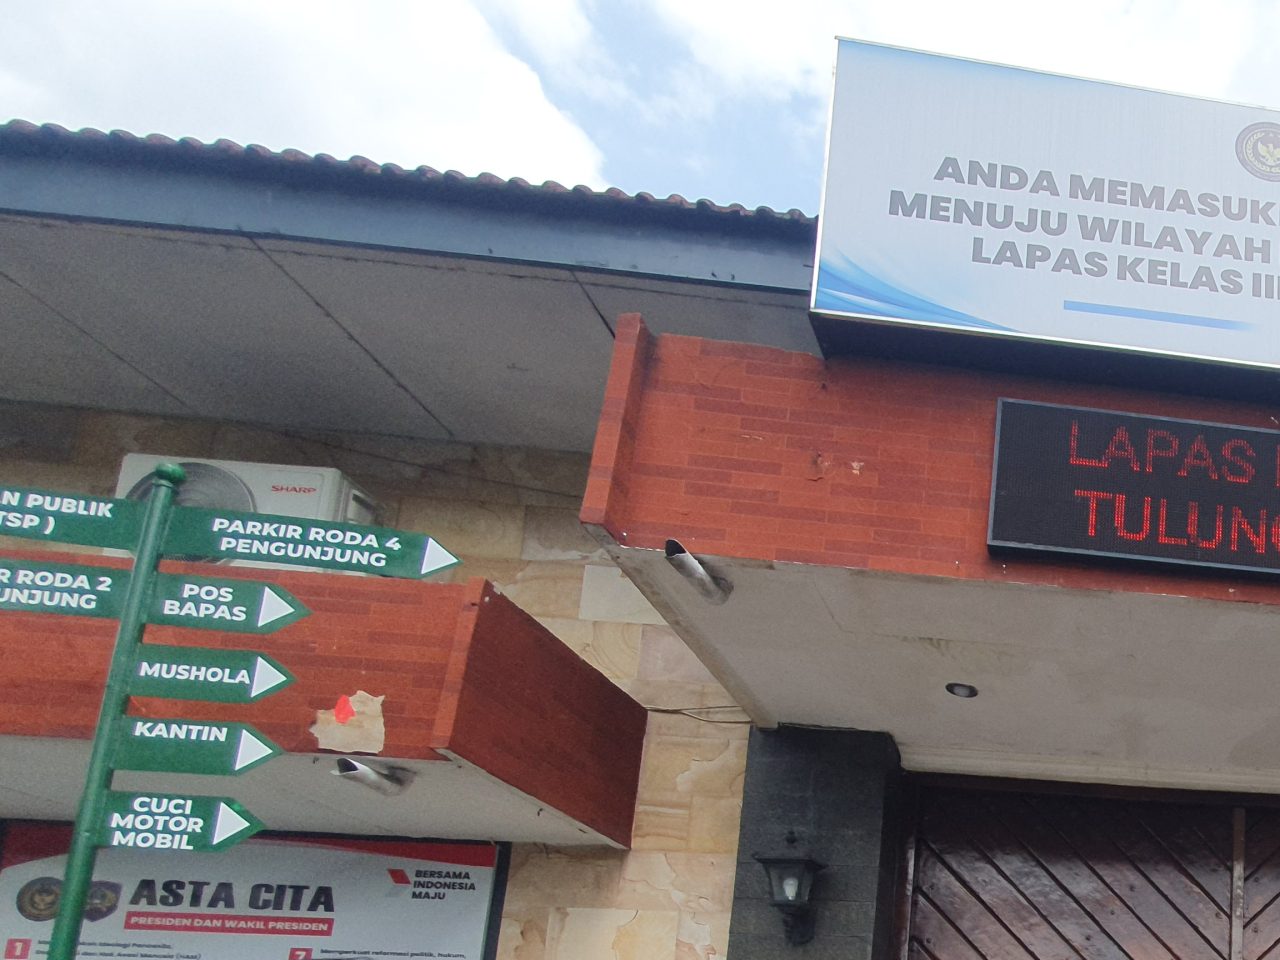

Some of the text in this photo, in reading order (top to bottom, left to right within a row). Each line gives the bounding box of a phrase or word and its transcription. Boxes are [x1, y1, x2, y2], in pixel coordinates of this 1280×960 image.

[934, 156, 1060, 197] ANDA
[888, 190, 1068, 236] MENUJU
[1077, 214, 1271, 263] WILAYAH
[972, 237, 1108, 277] LAPAS
[1117, 255, 1243, 295] KELAS
[1070, 419, 1256, 484] LAPAS
[271, 484, 317, 495] SHARP
[26, 494, 114, 518] PUBLIK
[212, 518, 402, 552] PARKIR RODA 4
[220, 537, 387, 567] PENGUNJUNG
[16, 570, 91, 590] RODA
[96, 576, 112, 592] 2
[182, 583, 234, 602] POS
[163, 600, 247, 621] BAPAS
[139, 661, 251, 684] MUSHOLA
[134, 721, 228, 742] KANTIN
[133, 796, 193, 815] CUCI
[110, 812, 204, 833] MOTOR
[112, 830, 194, 850] MOBIL
[415, 869, 471, 880] BERSAMA
[129, 879, 335, 912] ASTA CITA
[411, 891, 446, 900] MAJU
[413, 880, 476, 891] INDONESIA
[130, 916, 329, 931] PRESIDEN DAN WAKIL PRESIDEN
[14, 942, 23, 956] 1
